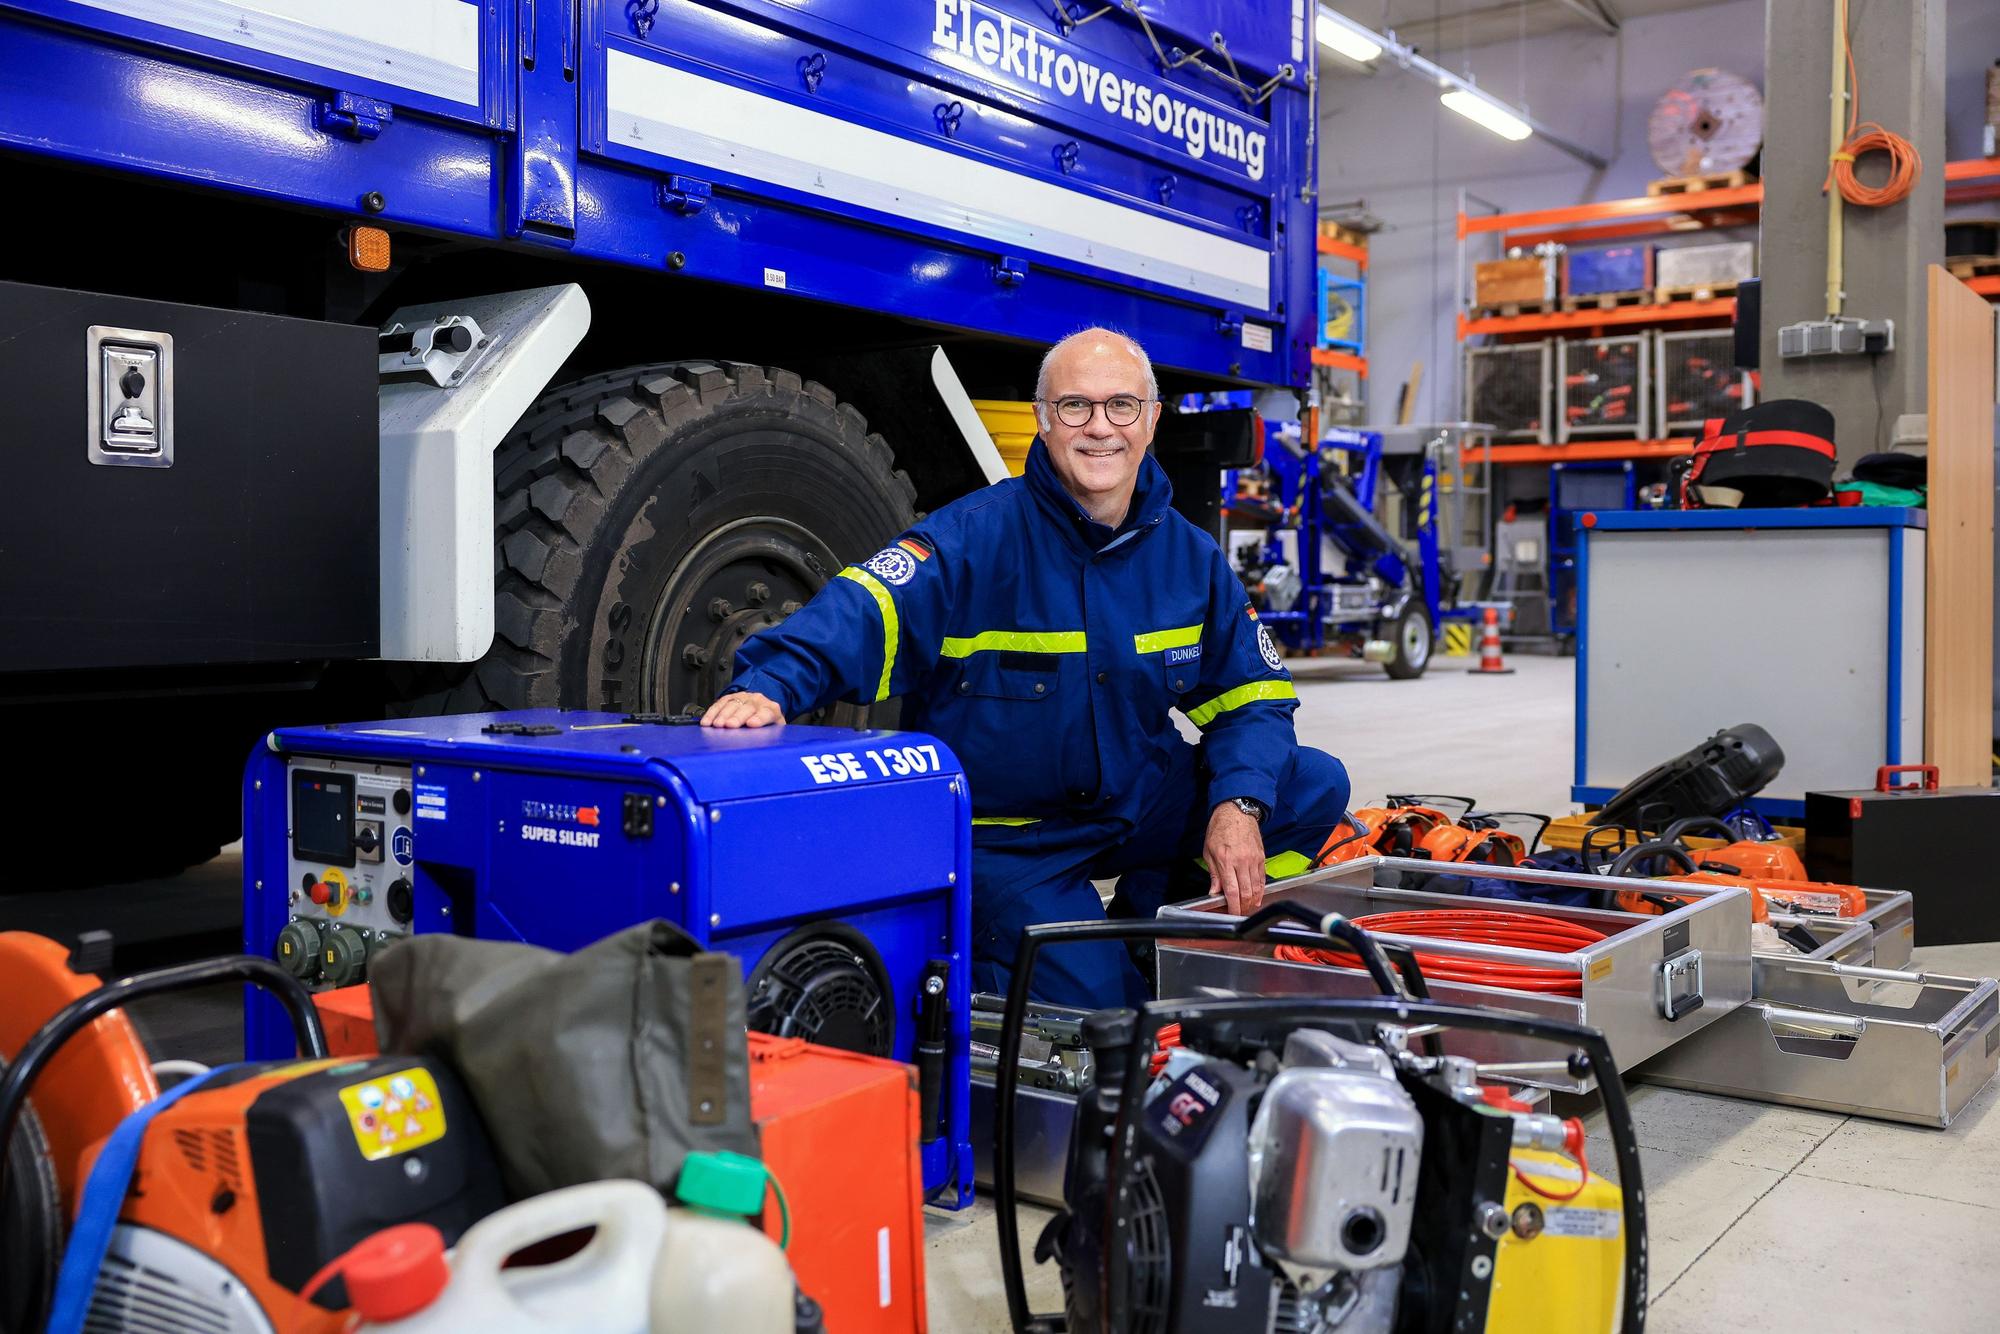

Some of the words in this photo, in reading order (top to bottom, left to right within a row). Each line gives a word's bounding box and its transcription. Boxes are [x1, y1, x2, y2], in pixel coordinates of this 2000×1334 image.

[932, 0, 1266, 182] Elektroversorgung
[776, 274, 785, 284] BAR
[800, 752, 868, 784] ESE
[865, 744, 941, 777] 1307
[521, 825, 557, 843] SUPER
[559, 829, 600, 848] SILENT
